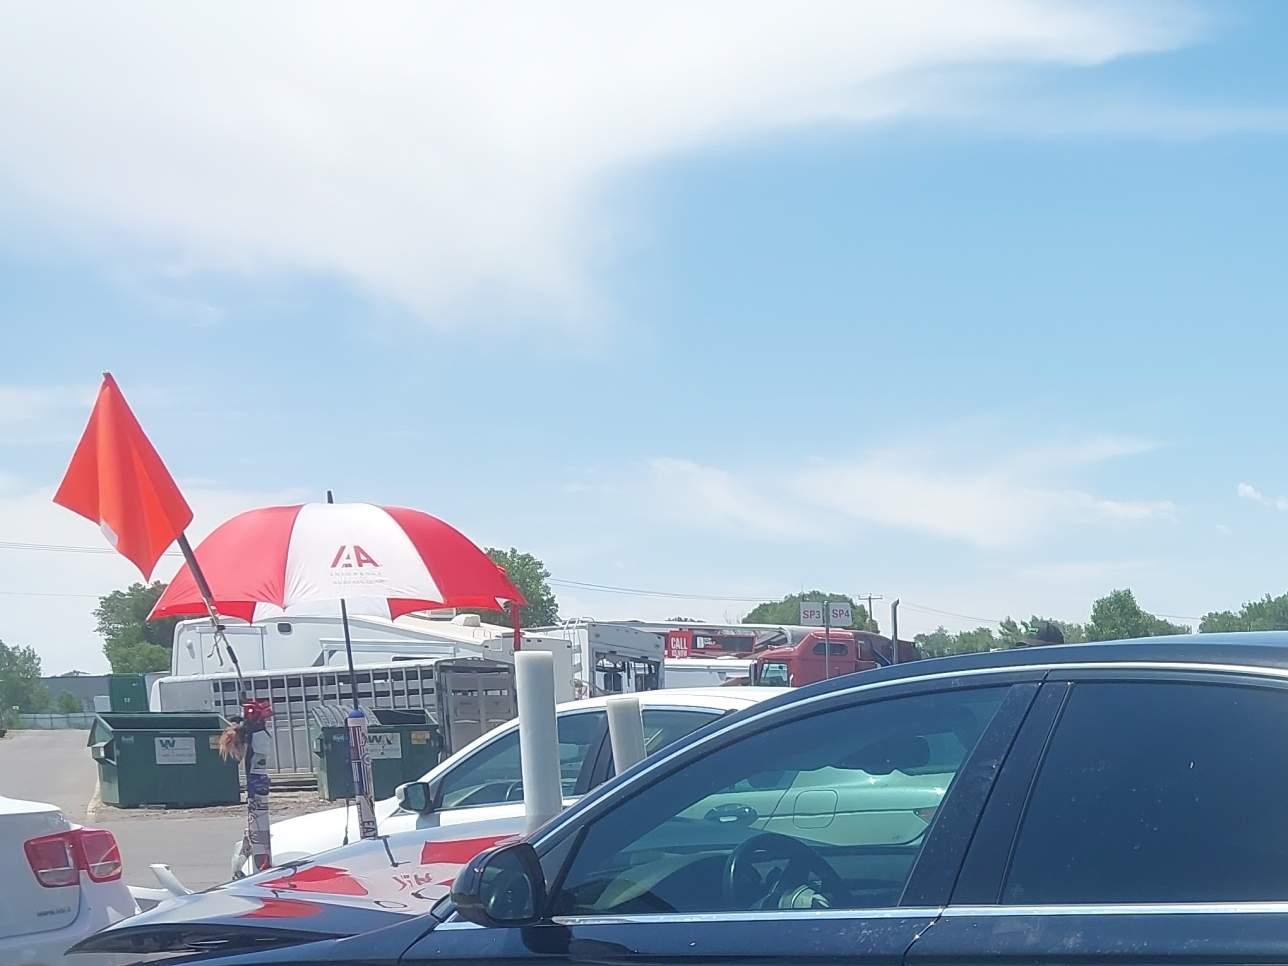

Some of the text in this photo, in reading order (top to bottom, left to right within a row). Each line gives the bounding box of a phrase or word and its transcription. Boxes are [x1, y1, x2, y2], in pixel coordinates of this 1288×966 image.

[803, 610, 821, 619] SP3
[831, 609, 850, 618] SP4
[670, 637, 688, 650] CALL
